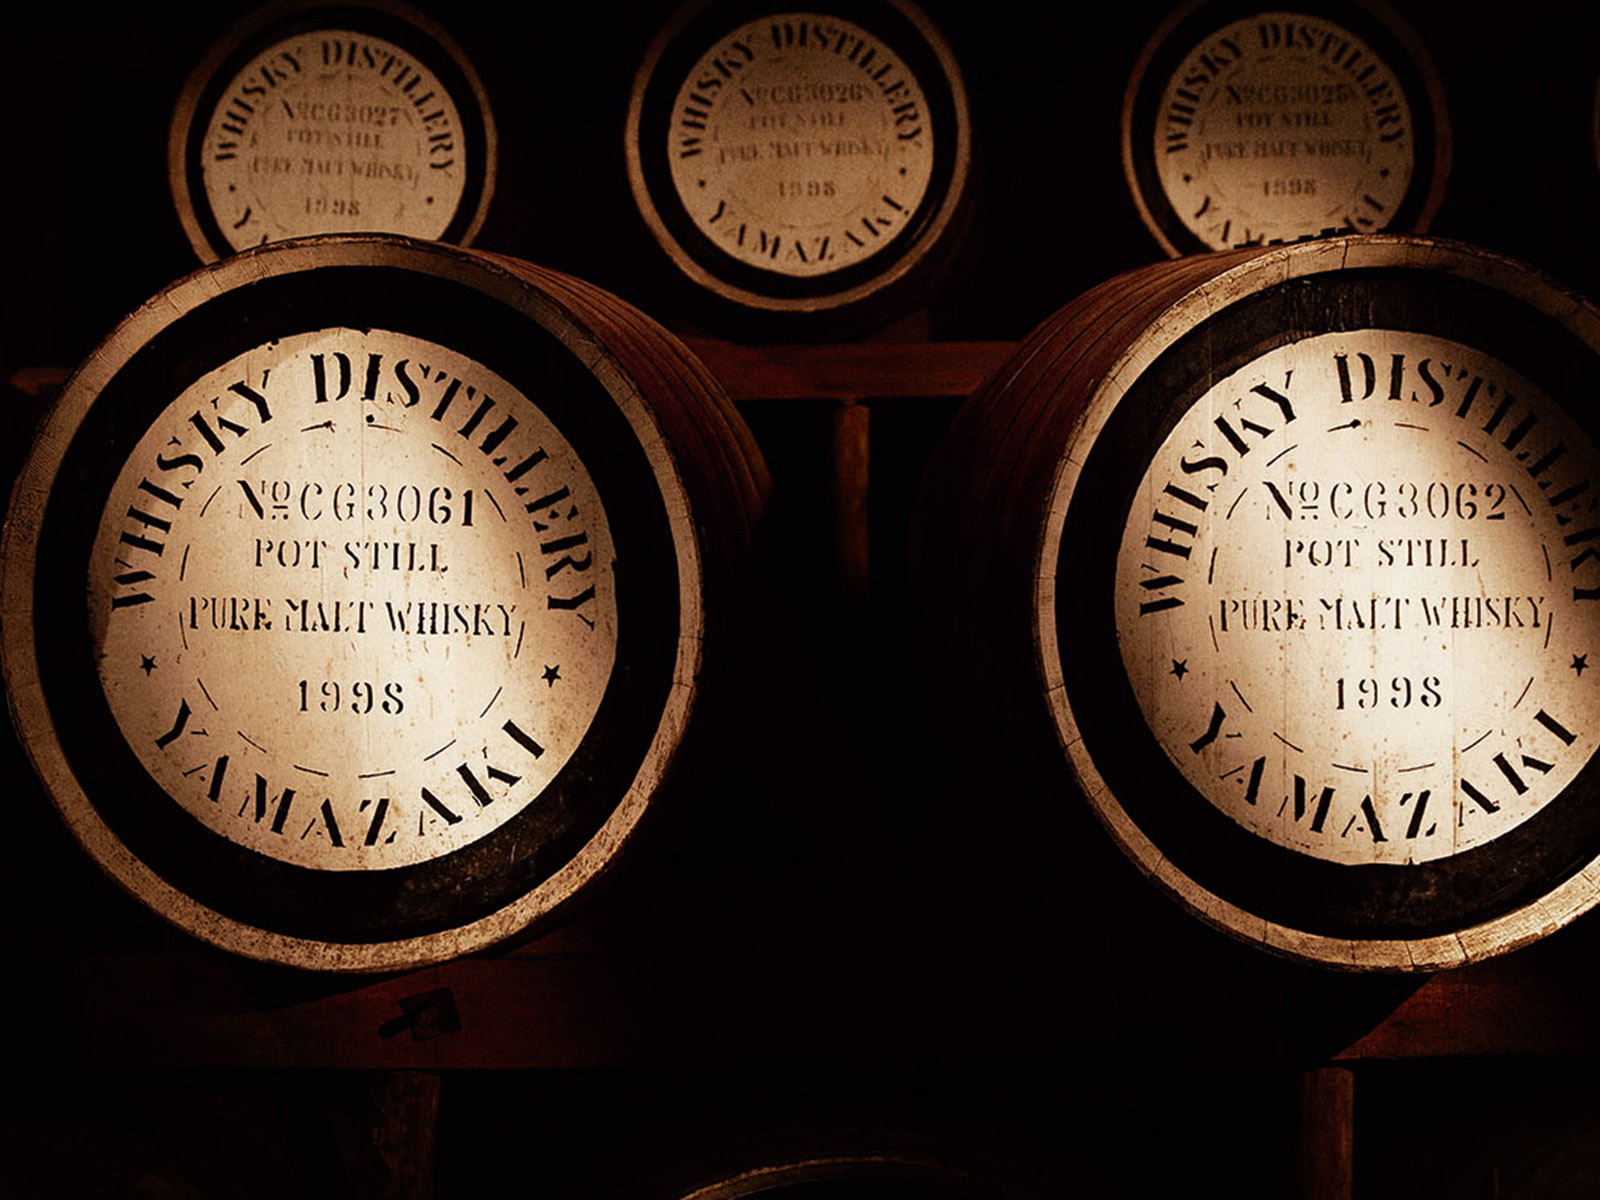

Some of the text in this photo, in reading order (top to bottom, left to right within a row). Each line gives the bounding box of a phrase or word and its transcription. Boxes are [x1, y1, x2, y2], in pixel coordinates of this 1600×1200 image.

[215, 40, 455, 178] WHISKY DISTILLERY
[681, 22, 923, 158] WHISKY DISTILLERY
[1166, 23, 1405, 152] WHISKY DISTILLERY
[286, 129, 384, 149] POT STILL
[305, 196, 361, 216] 1998
[709, 195, 902, 264] YAMAZAKI
[112, 351, 595, 630] WHISKY DISTILLERY
[1140, 370, 1296, 616] WHISKY
[254, 538, 449, 572] POT STILL
[1284, 539, 1480, 568] POT STILL
[189, 596, 517, 637] PURE MALT WHISKY
[1219, 597, 1545, 632] PURE MALT WHISKY
[299, 680, 405, 715] 1998
[1335, 676, 1443, 710] 1998
[155, 698, 545, 848] YAMAZAKI
[1189, 702, 1577, 843] YAMAZAKI
